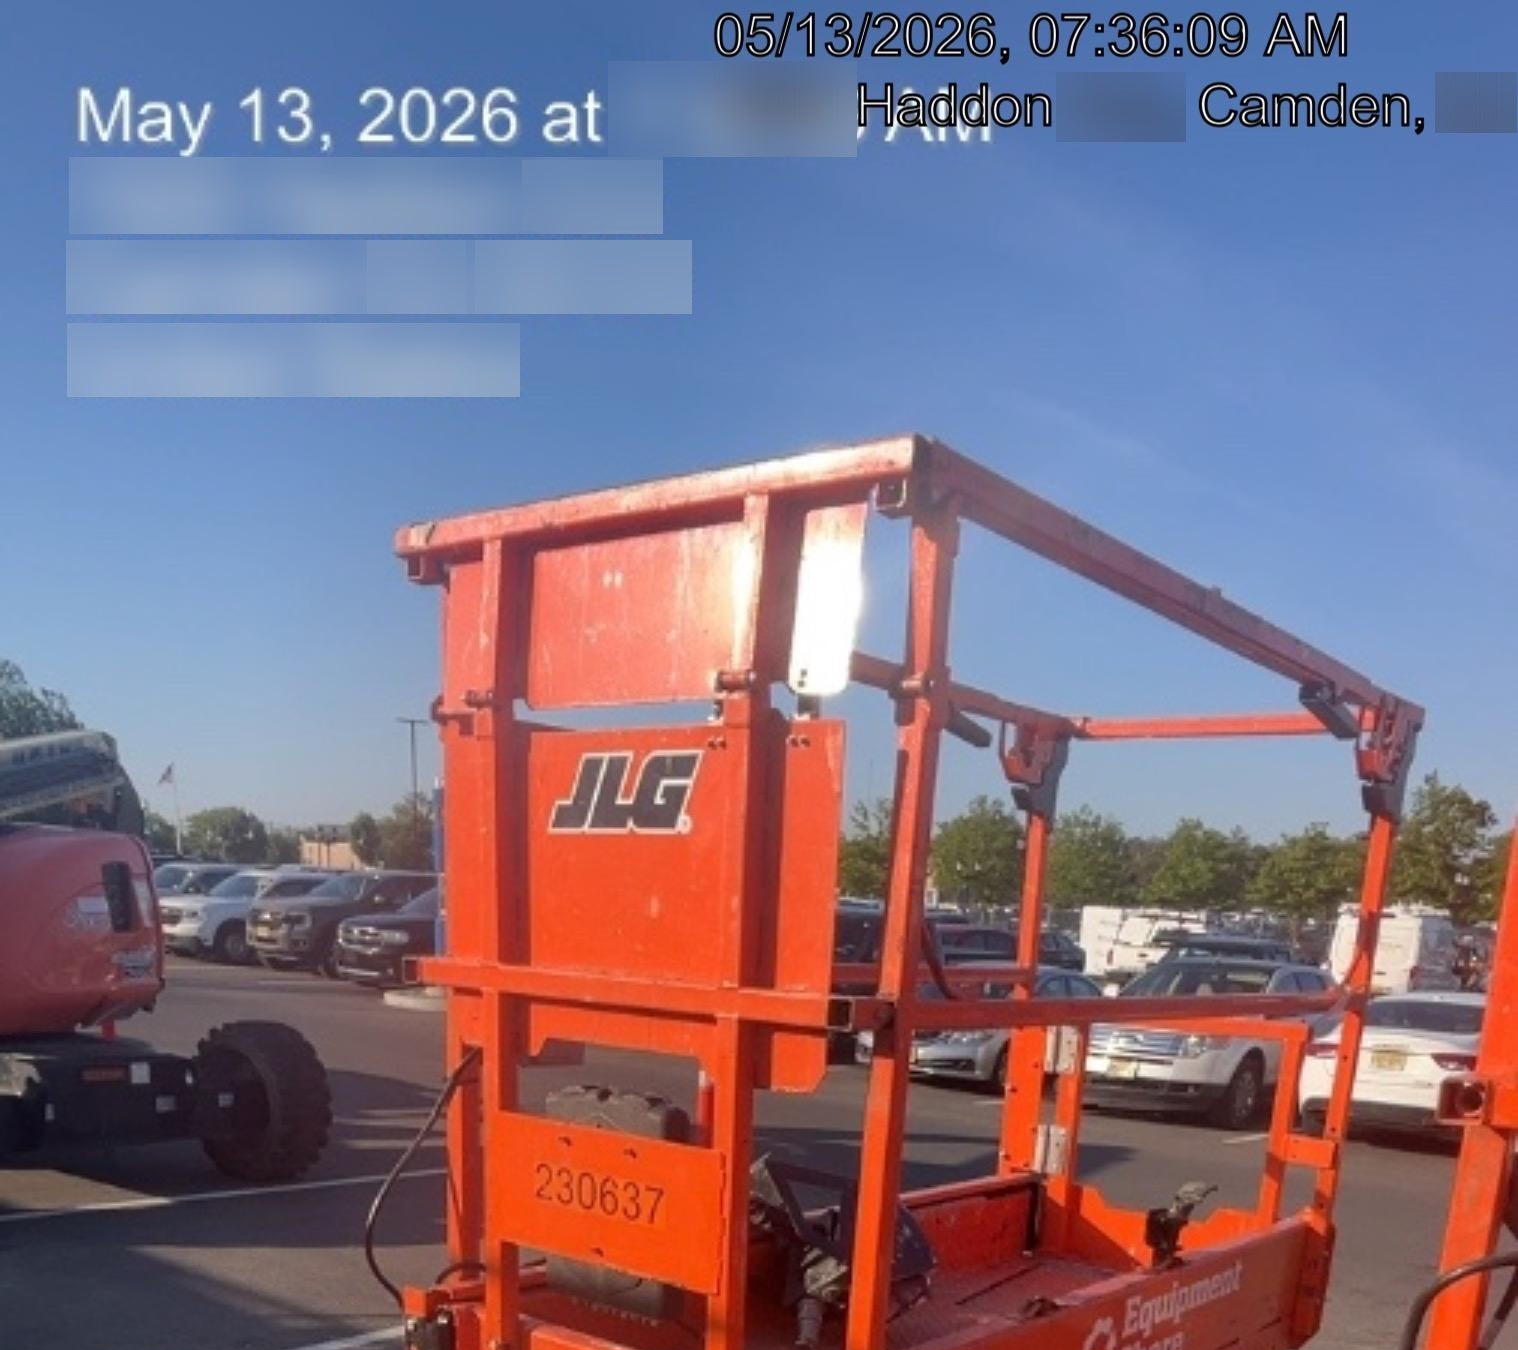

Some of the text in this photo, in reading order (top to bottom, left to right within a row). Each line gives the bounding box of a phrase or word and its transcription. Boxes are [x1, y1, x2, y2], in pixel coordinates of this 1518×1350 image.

[548, 749, 704, 834] JLG
[534, 1162, 666, 1225] 230637
[1121, 1259, 1243, 1339] Equipment
